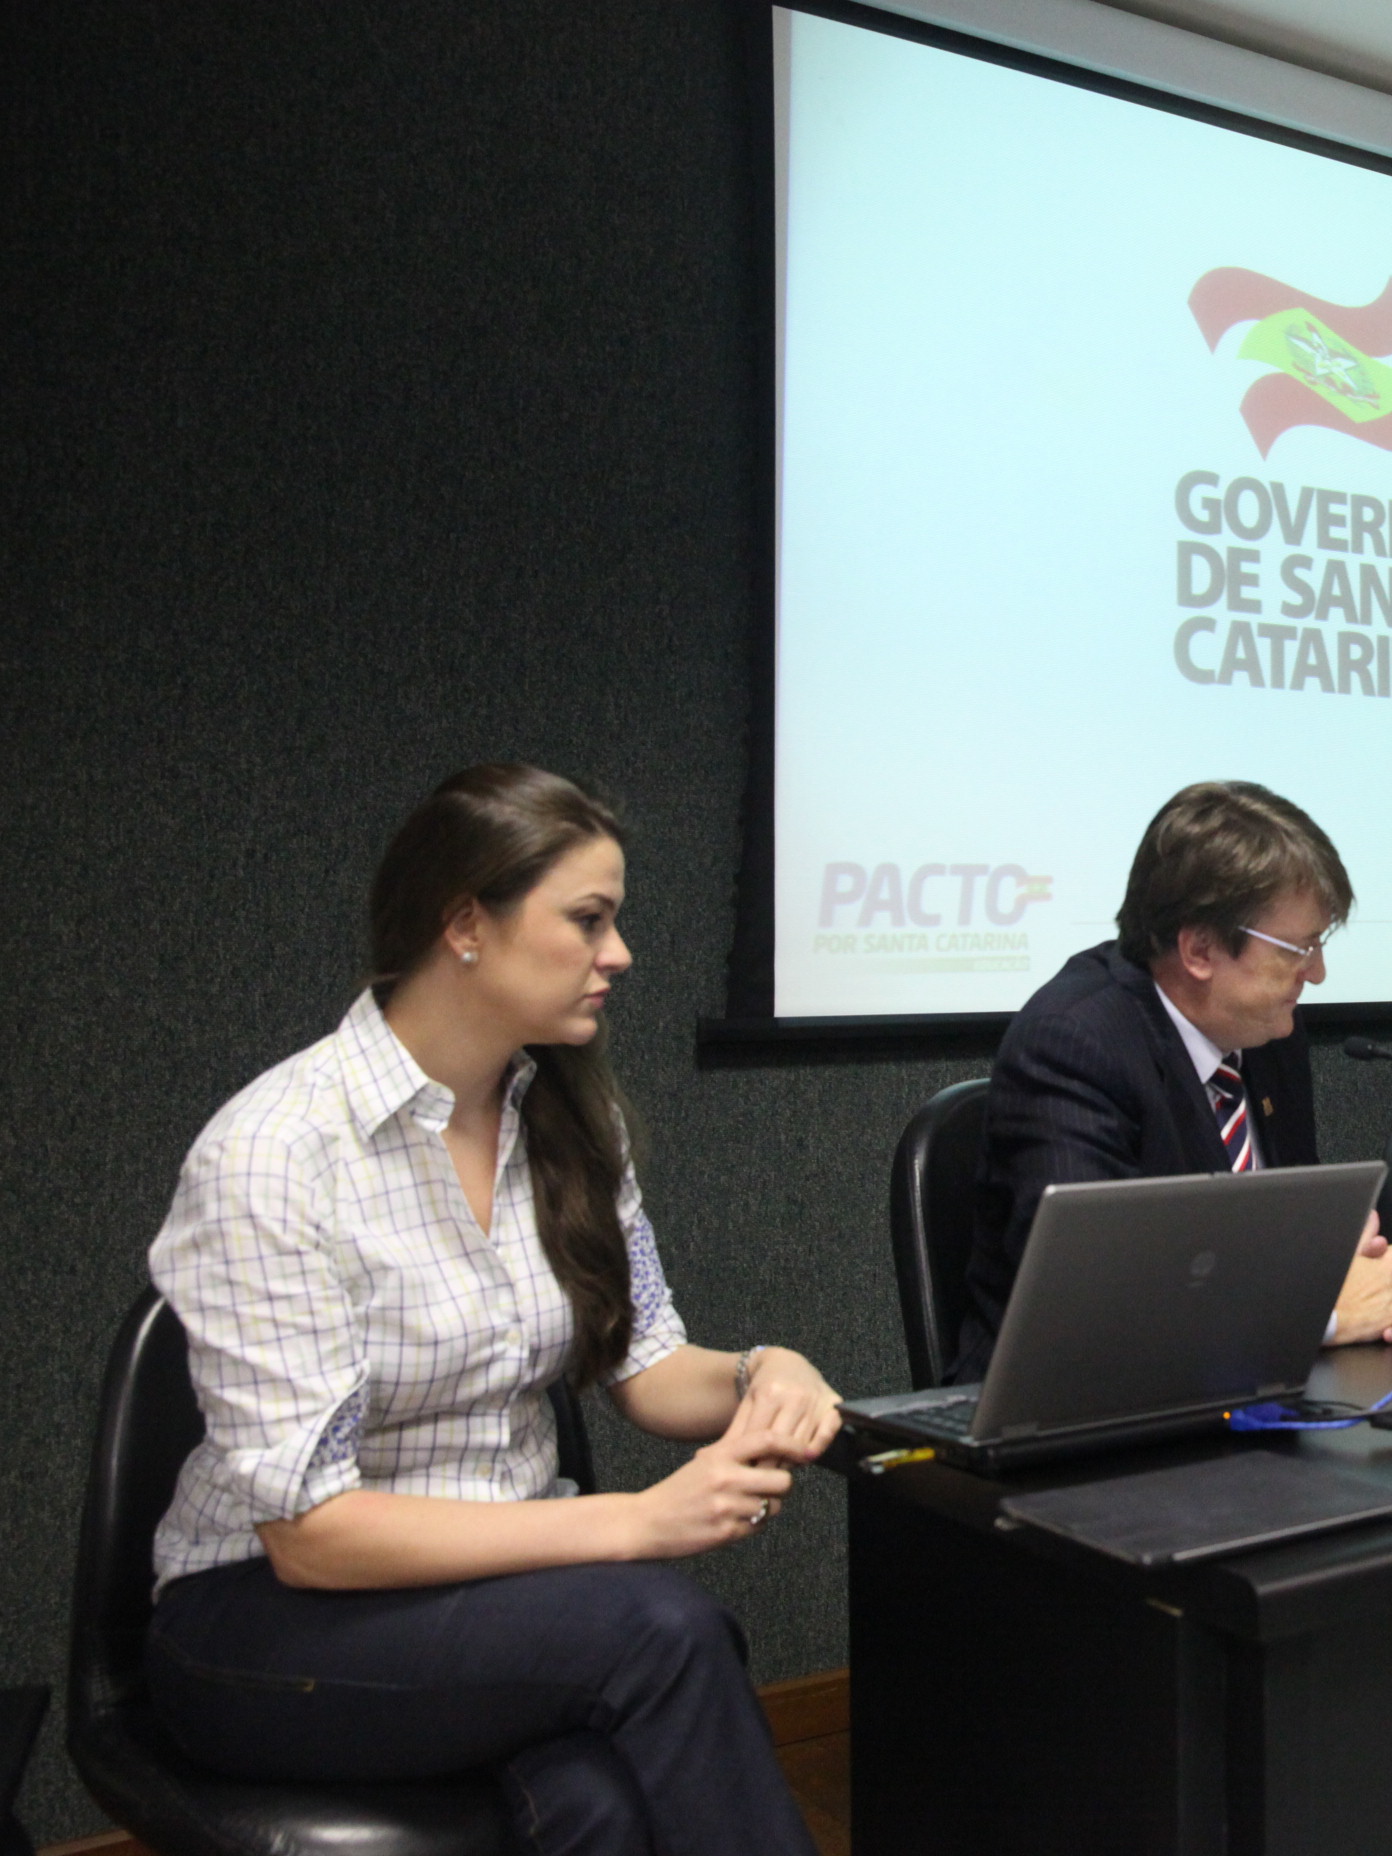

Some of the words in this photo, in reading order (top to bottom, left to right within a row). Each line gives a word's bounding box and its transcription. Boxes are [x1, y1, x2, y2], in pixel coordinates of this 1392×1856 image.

[1176, 540, 1263, 615] DE
[817, 862, 1032, 928] PACTO
[813, 934, 858, 954] POR
[863, 933, 929, 953] SANTA
[935, 932, 1029, 951] CATARINA
